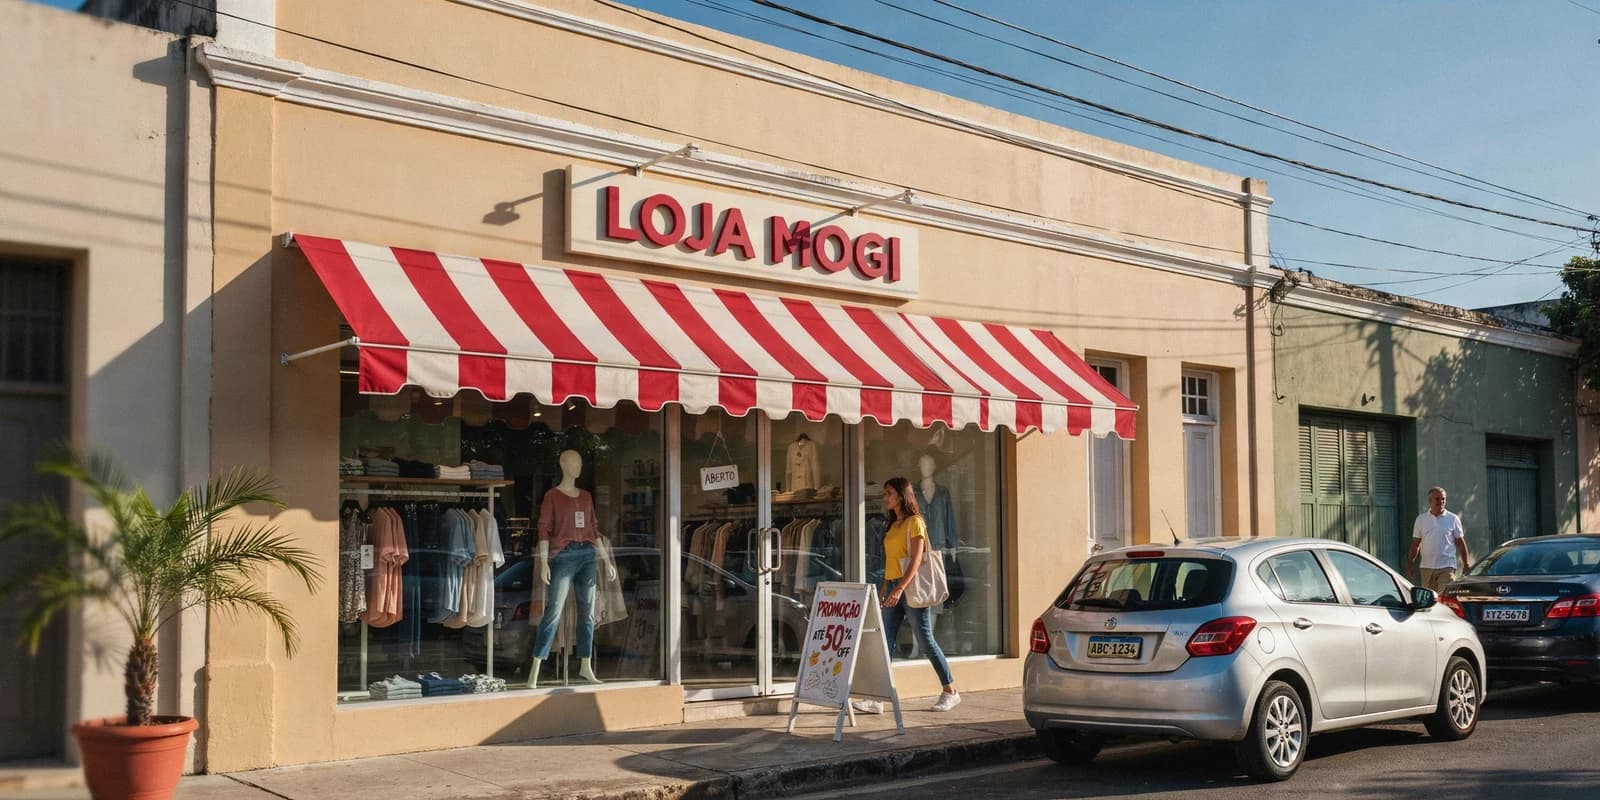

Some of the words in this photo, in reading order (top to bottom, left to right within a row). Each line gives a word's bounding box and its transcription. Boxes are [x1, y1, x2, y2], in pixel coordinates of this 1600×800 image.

[604, 186, 756, 260] LOJA
[770, 215, 901, 282] MOGI
[704, 471, 736, 486] ABERTO
[816, 600, 861, 621] PROMOÇÃO
[812, 626, 826, 641] ATÉ
[836, 647, 851, 658] OFF
